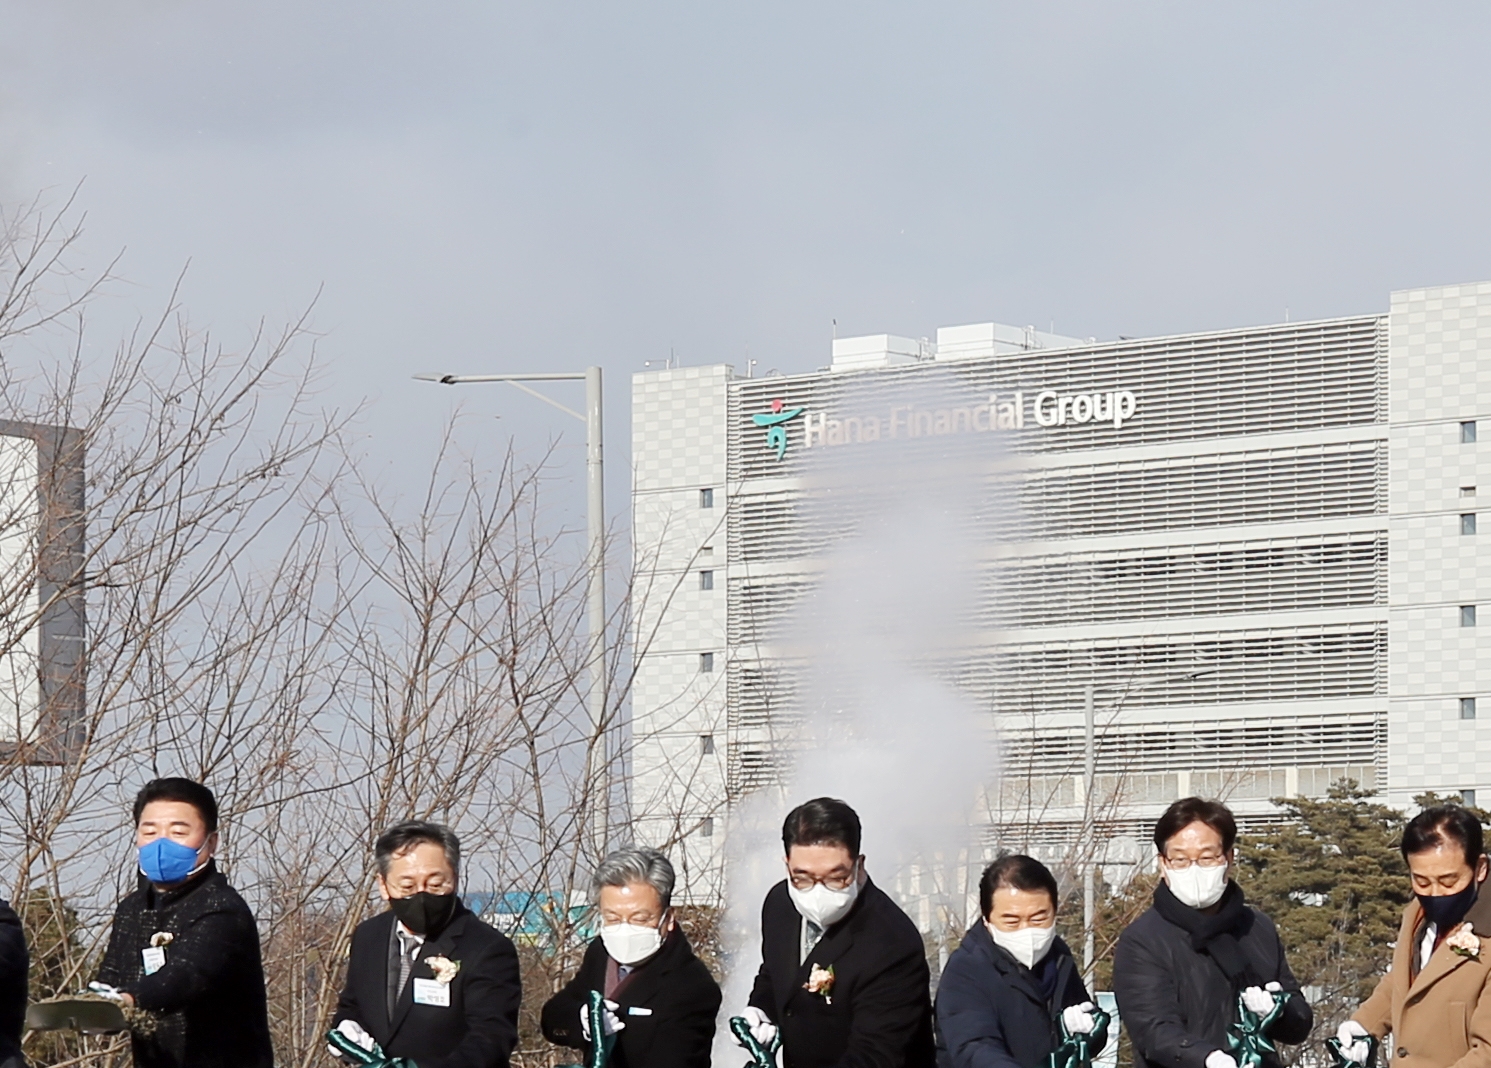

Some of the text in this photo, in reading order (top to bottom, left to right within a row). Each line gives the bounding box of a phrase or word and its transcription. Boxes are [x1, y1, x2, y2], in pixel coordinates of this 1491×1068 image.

[804, 389, 1137, 448] Hana Financial Group
